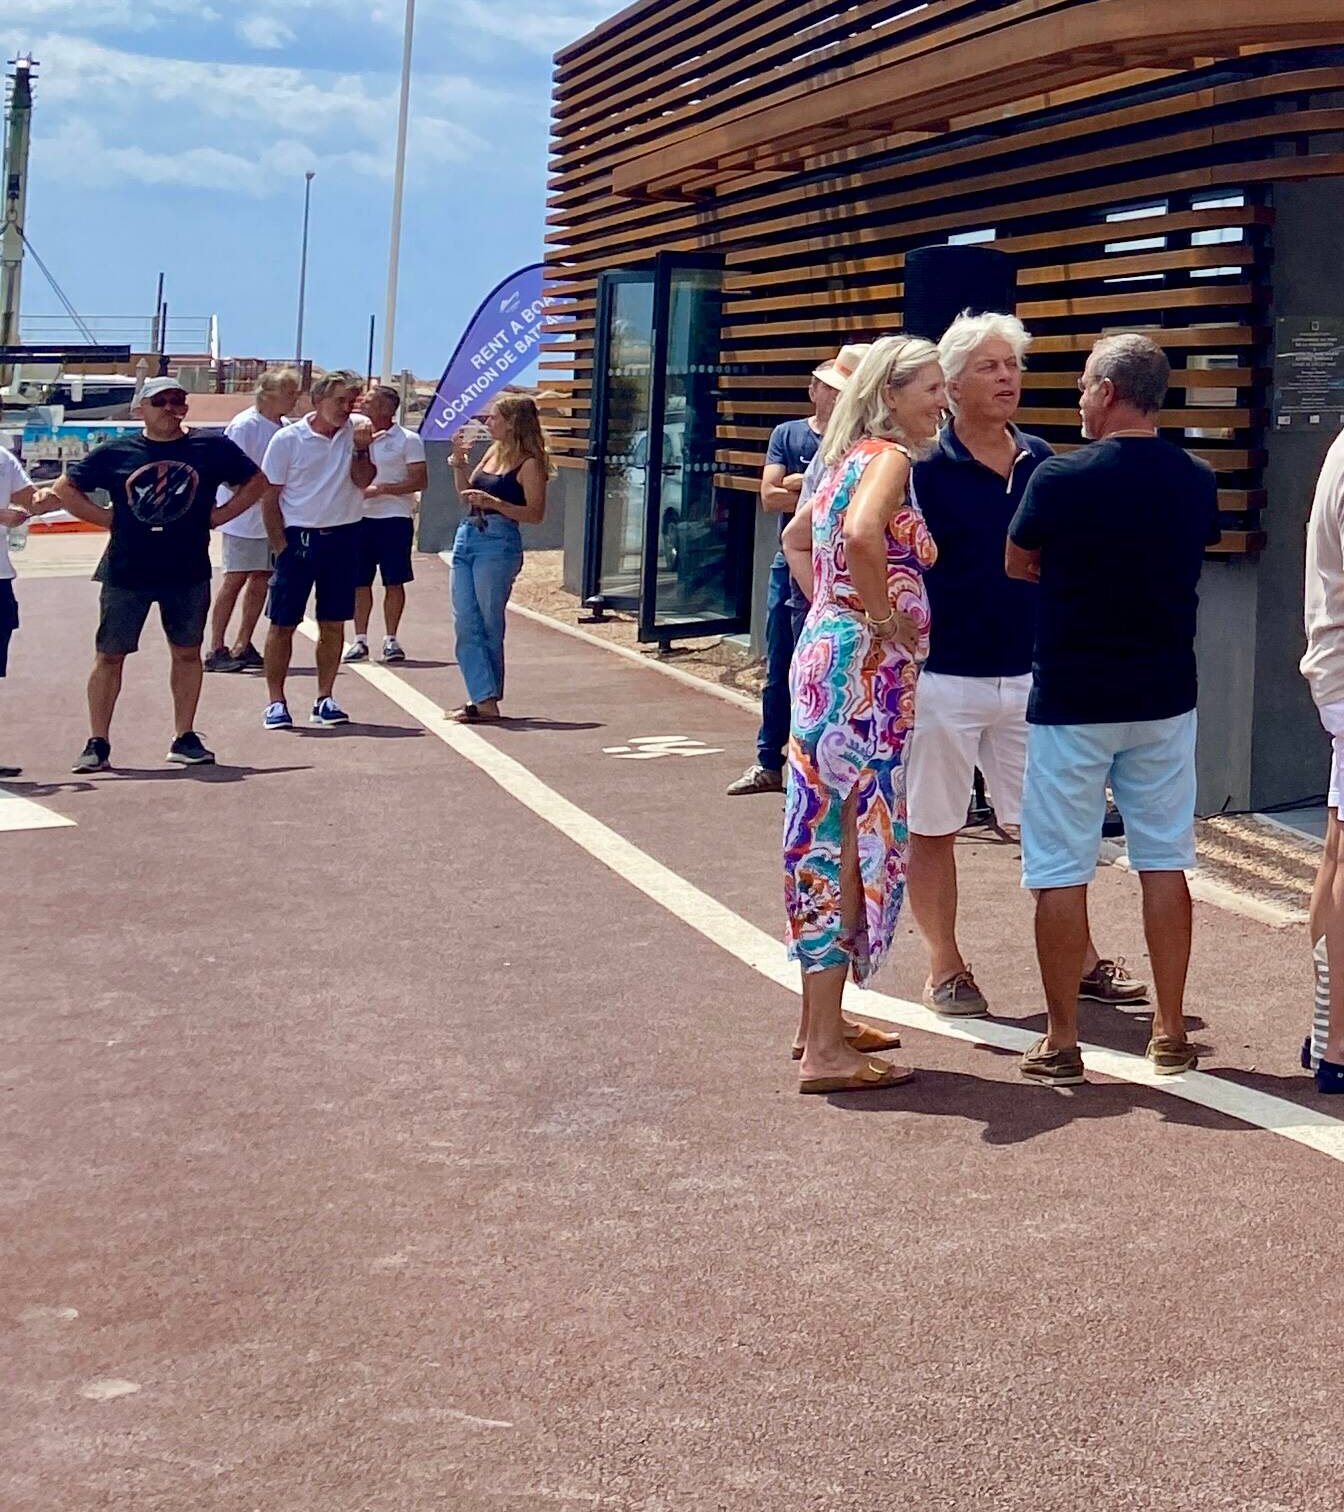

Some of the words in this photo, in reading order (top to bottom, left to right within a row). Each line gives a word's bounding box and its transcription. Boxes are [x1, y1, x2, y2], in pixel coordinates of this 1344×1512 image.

[470, 329, 509, 370] RENT
[510, 320, 524, 335] A
[434, 367, 500, 429] LOCATION
[495, 350, 517, 371] DE
